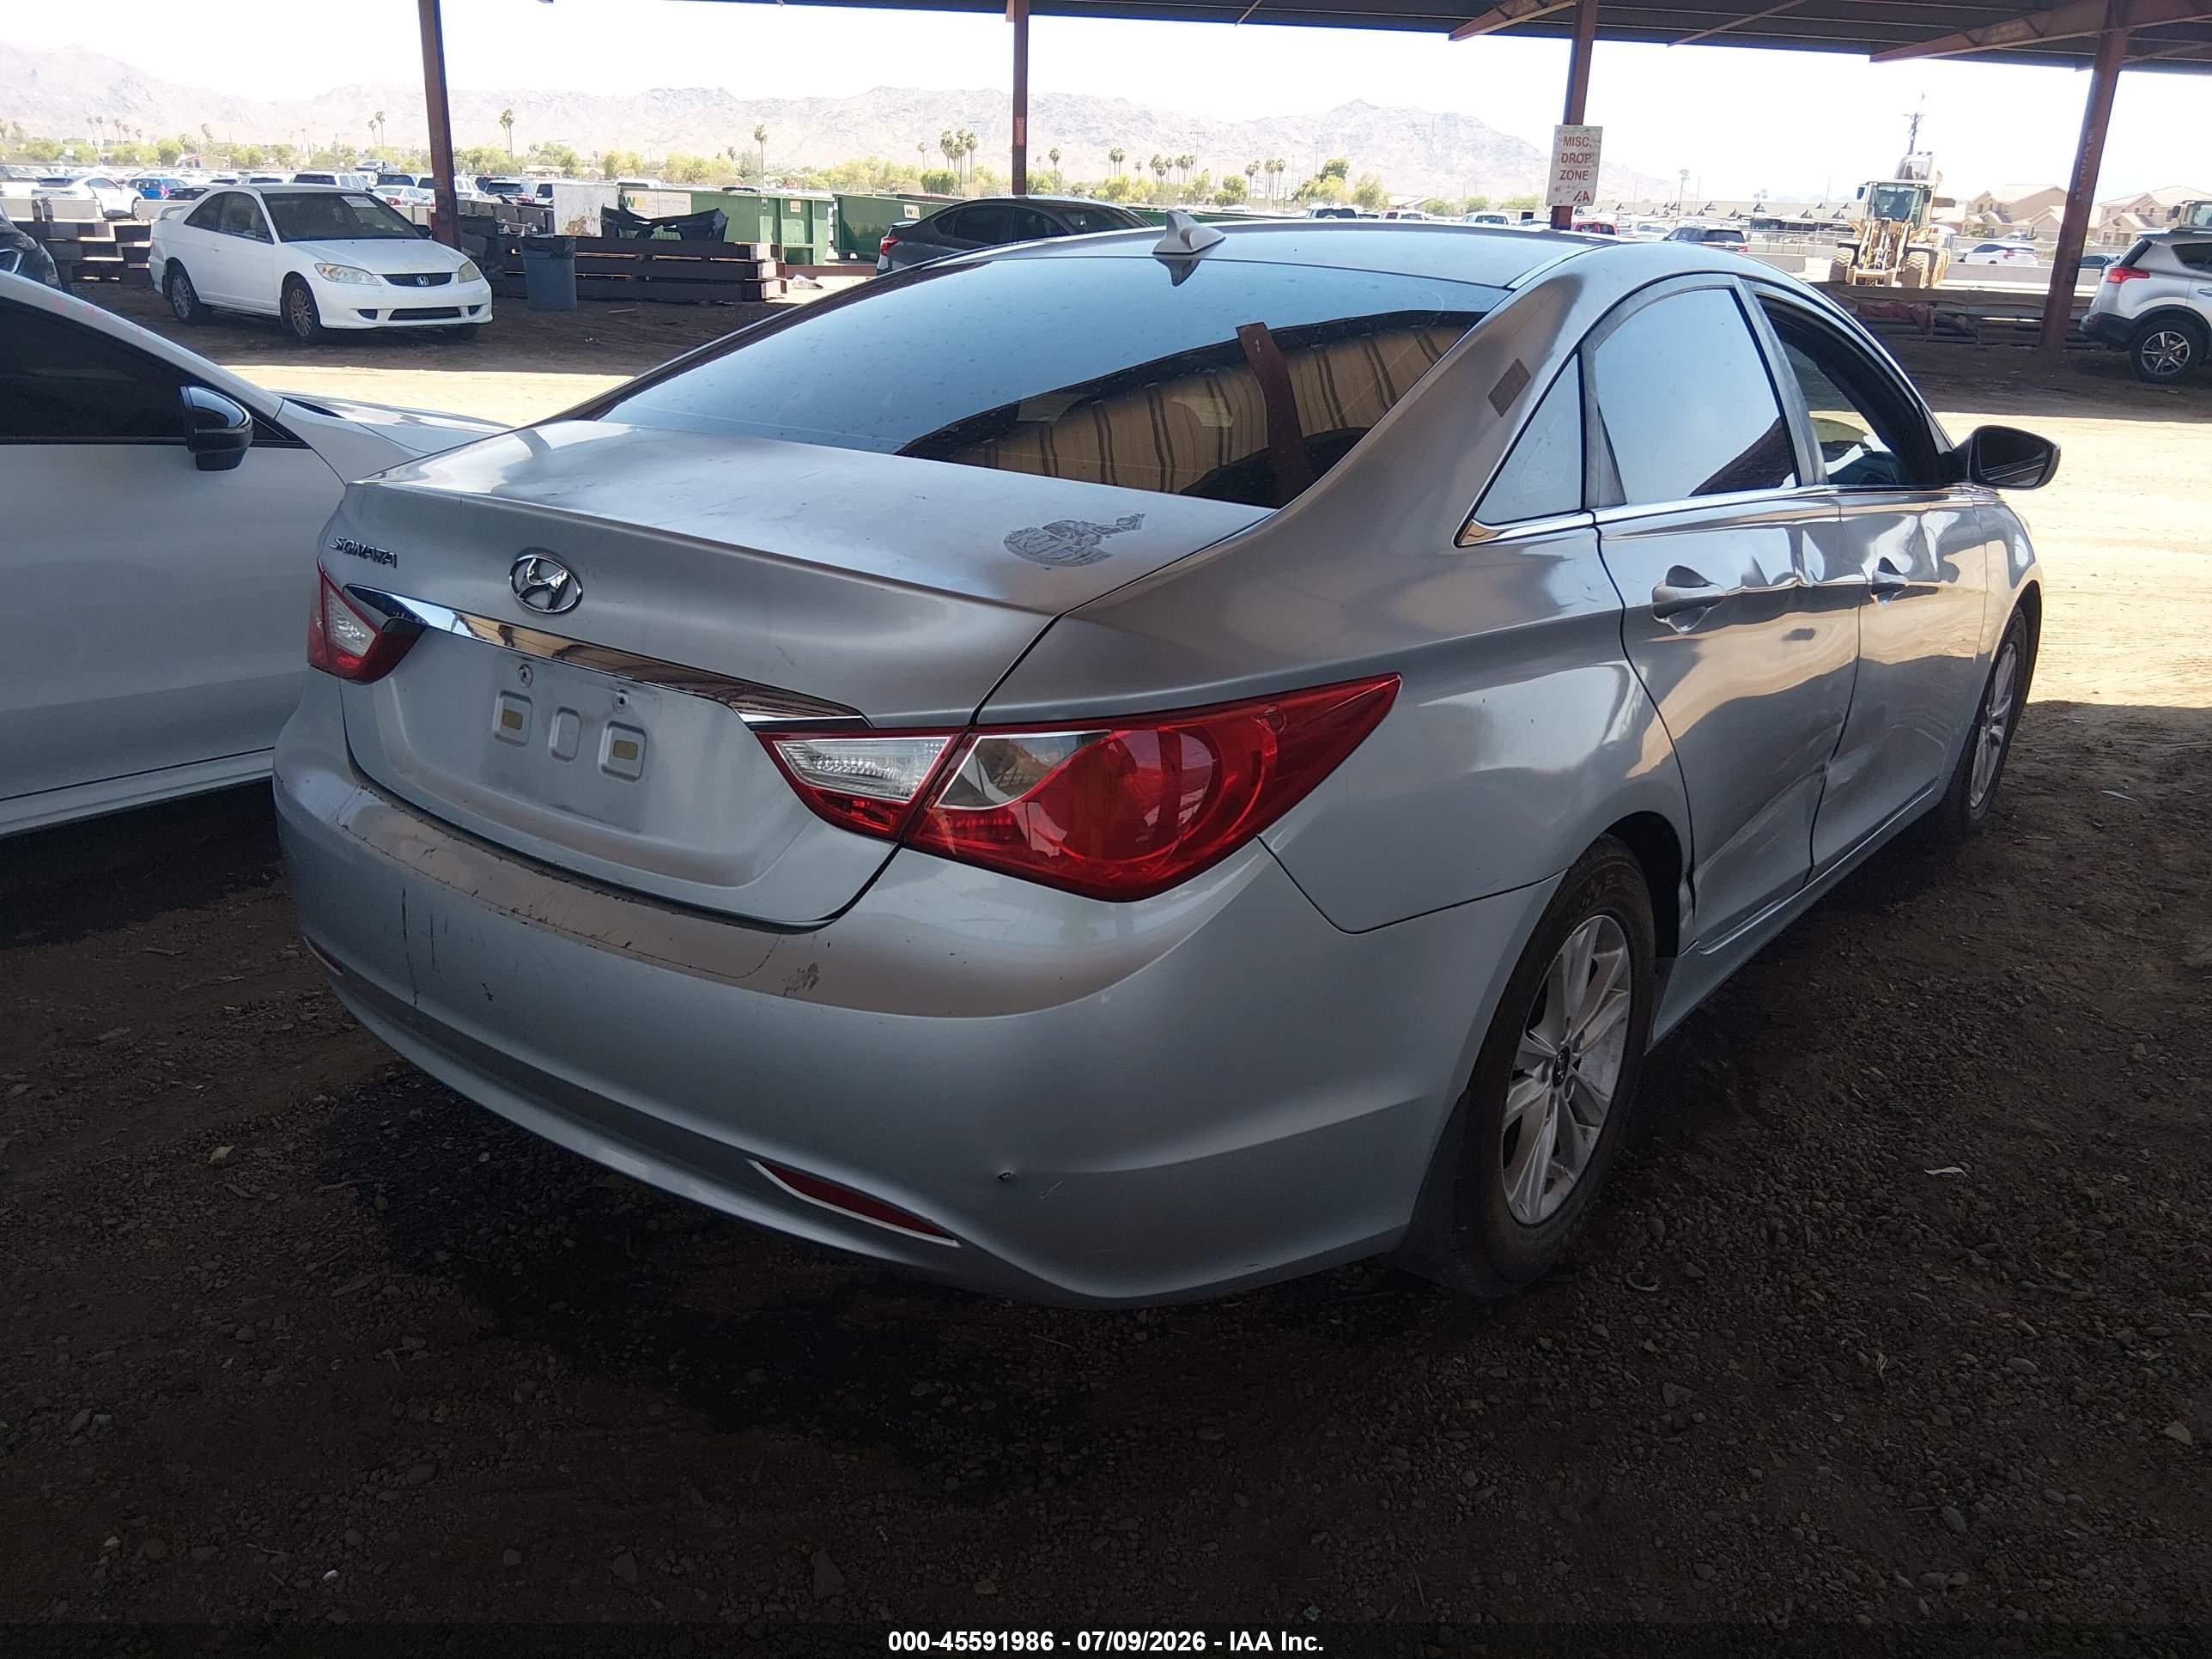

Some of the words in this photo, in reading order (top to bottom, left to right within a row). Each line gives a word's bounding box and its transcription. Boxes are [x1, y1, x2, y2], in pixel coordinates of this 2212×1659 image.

[1563, 136, 1592, 148] MISC.
[1560, 153, 1592, 164] DROP
[1559, 169, 1589, 180] ZONE
[329, 536, 398, 568] SONATA
